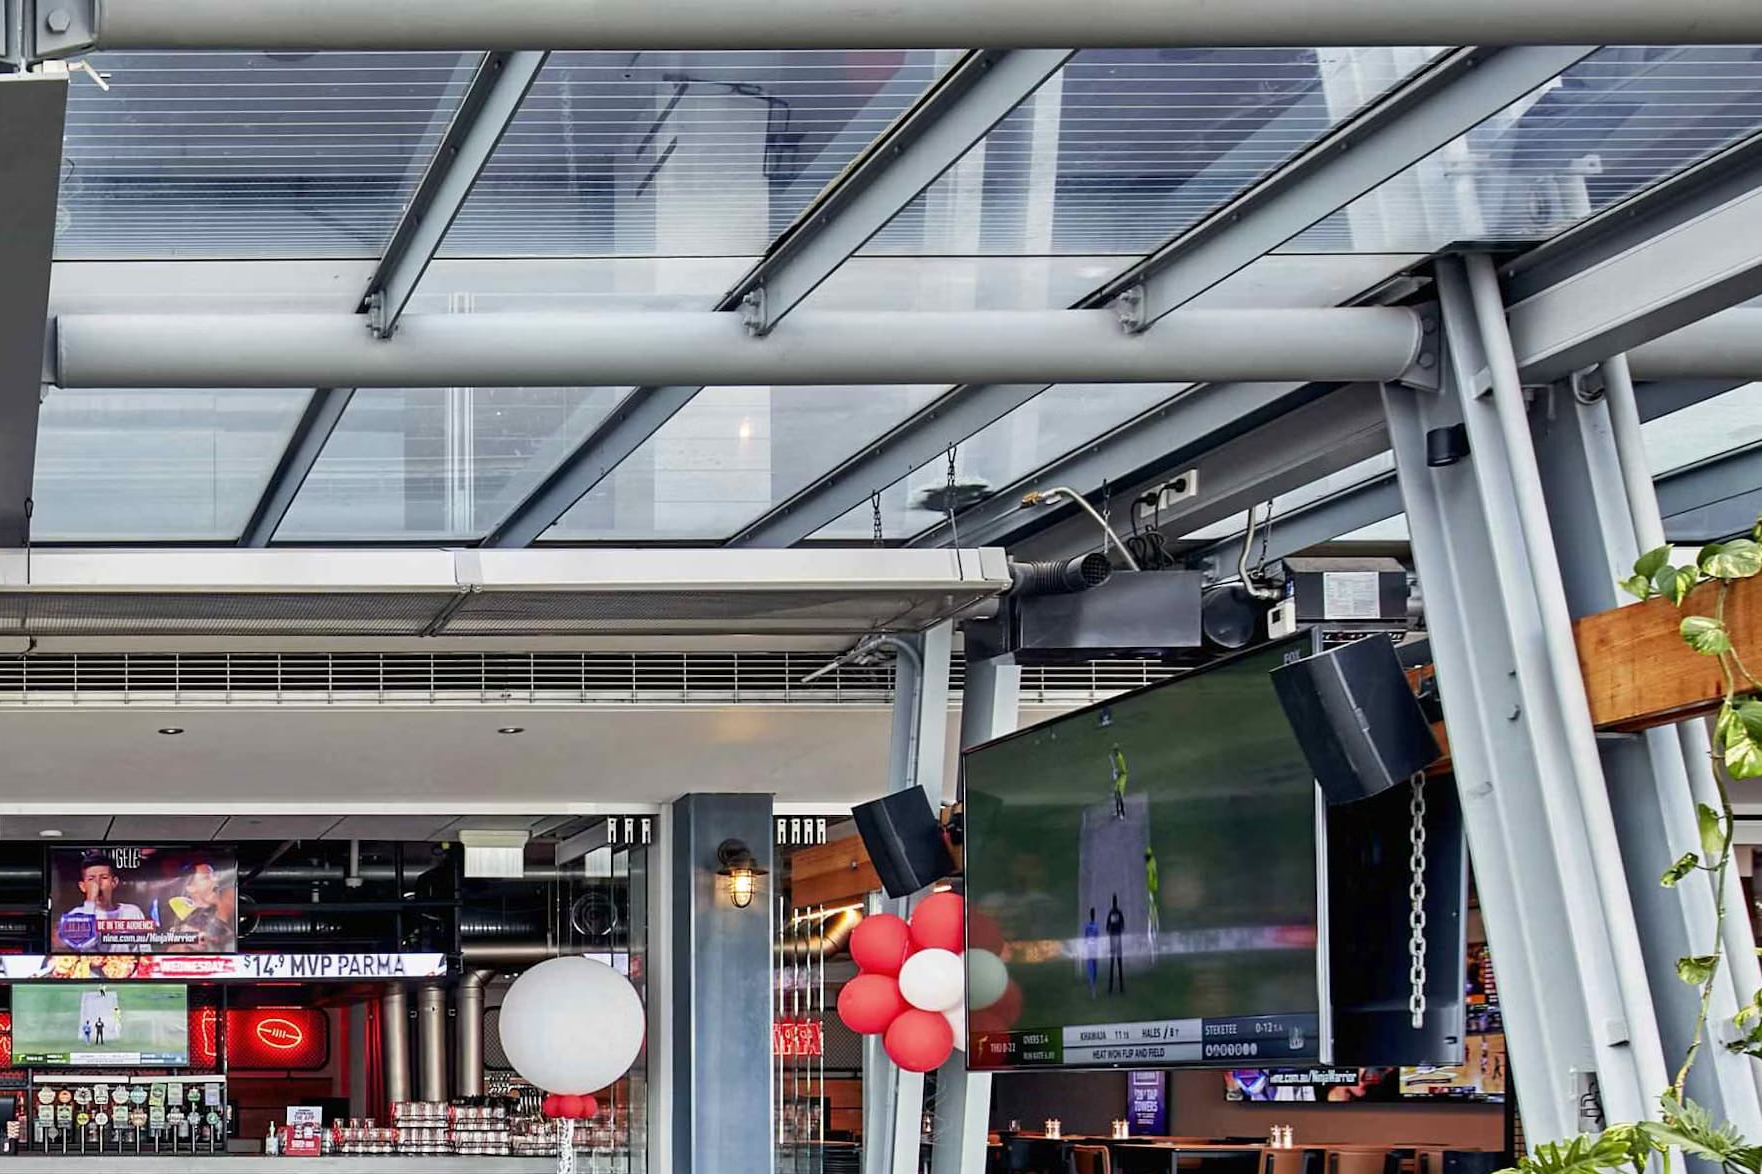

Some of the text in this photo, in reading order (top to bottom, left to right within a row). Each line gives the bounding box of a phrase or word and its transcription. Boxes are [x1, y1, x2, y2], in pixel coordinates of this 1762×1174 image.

[98, 921, 154, 930] BE IN THE AUDIENCE
[102, 931, 197, 944] nine.com.au/NinjaWarrior
[160, 960, 225, 972] WEDNESDAY
[290, 955, 332, 976] MVP
[338, 955, 406, 976] PARMA
[1142, 1027, 1161, 1039] HALES
[1205, 1024, 1237, 1036] STEKETEE
[1255, 1022, 1272, 1033] 0-12
[1093, 1047, 1165, 1060] HEAT WON FLIP AND FIELD
[1134, 1100, 1158, 1112] TOWERS
